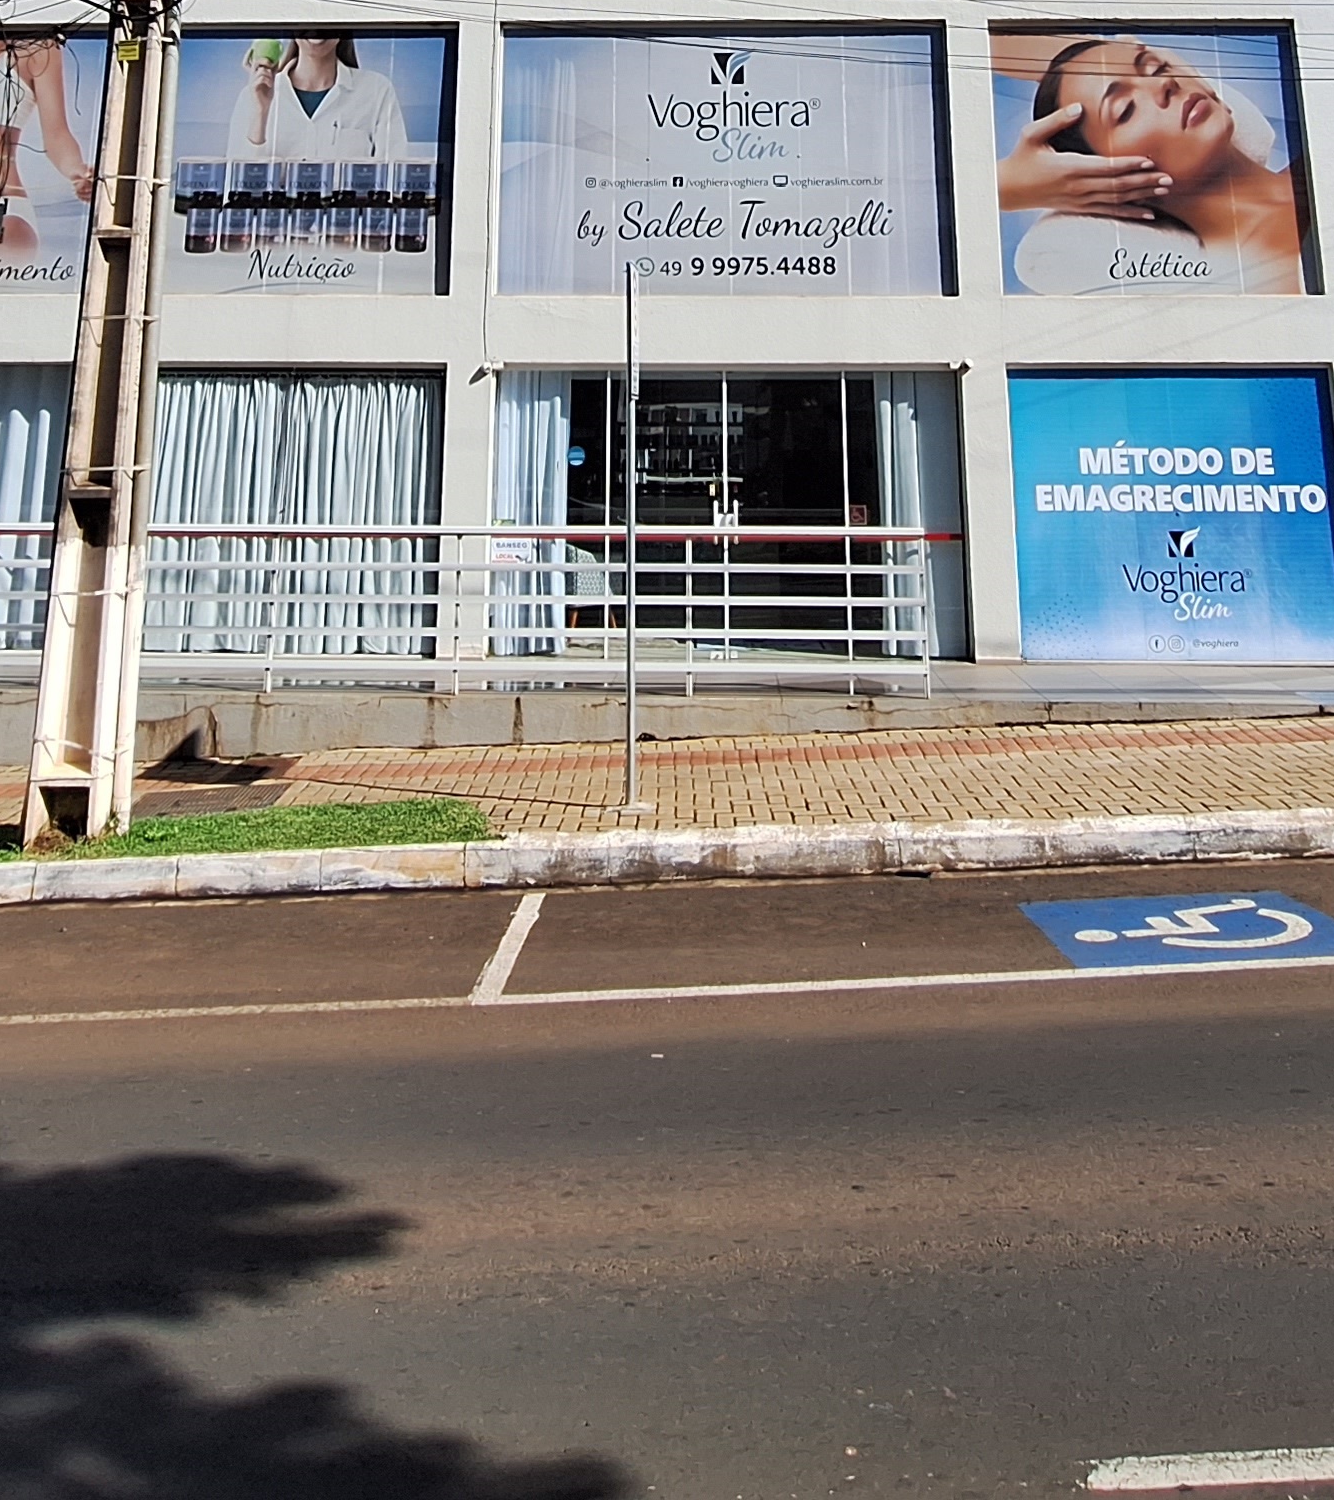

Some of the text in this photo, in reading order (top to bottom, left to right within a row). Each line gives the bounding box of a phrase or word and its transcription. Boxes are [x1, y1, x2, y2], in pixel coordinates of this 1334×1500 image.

[712, 127, 790, 163] Slim
[599, 177, 668, 189] @voghieraslim
[789, 176, 884, 188] voghieraslim.com.br
[577, 199, 894, 248] by Salete Tomazelli
[247, 248, 357, 284] Nutrição
[659, 256, 837, 276] 49 9 9975.4488
[1109, 247, 1212, 282] Estética
[1078, 440, 1275, 476] MÉTODO DE
[1035, 483, 1327, 514] EMAGRECIMENTO
[1173, 592, 1233, 621] Slim
[1192, 638, 1240, 649] @voghiera
